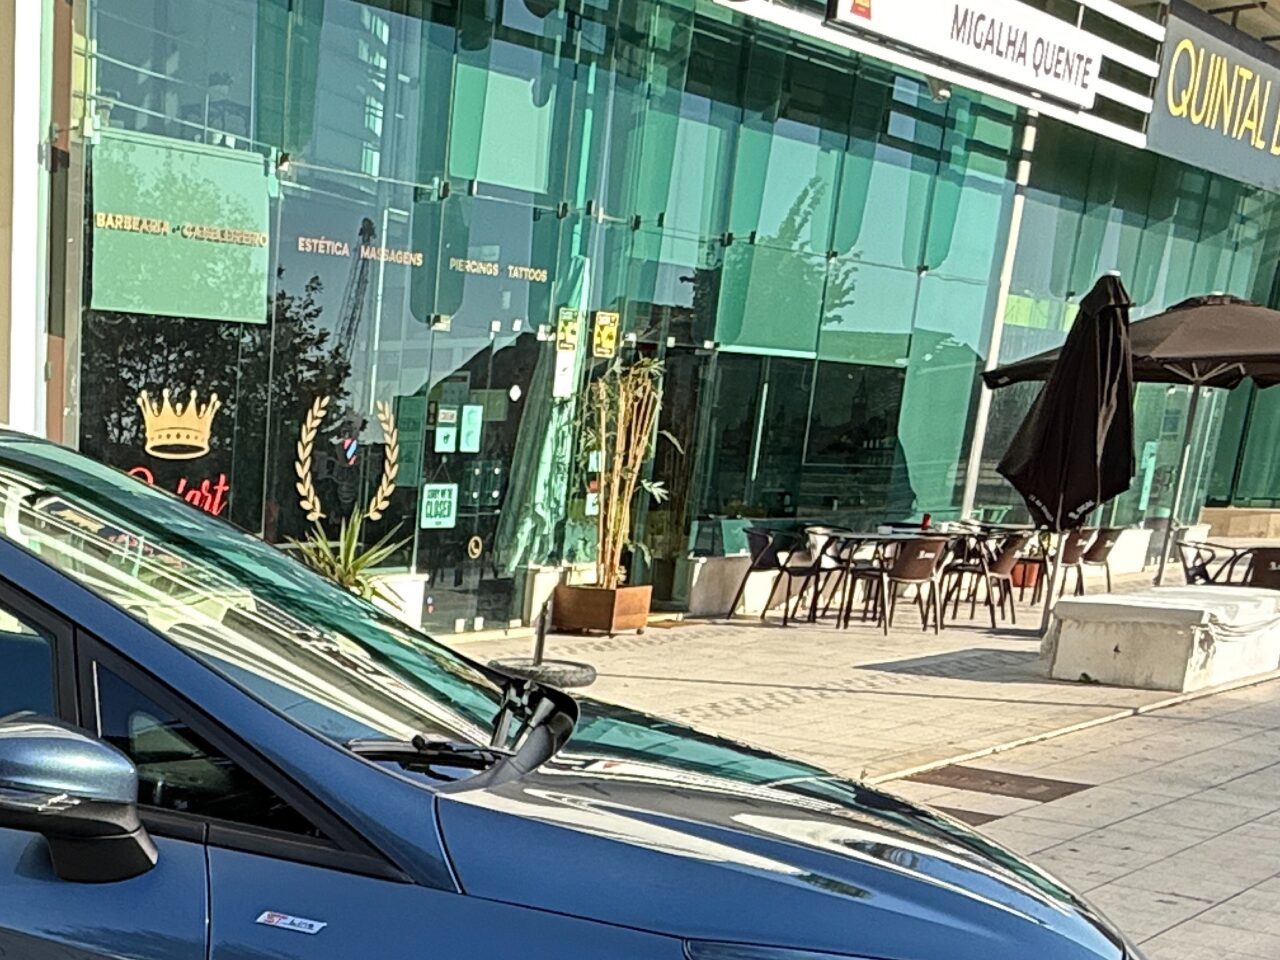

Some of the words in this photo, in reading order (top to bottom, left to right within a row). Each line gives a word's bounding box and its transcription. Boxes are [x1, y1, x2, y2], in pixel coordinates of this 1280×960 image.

[949, 3, 1029, 67] MIGALHA
[1032, 36, 1093, 90] QUENTE
[1167, 38, 1272, 150] QUINTAL
[297, 235, 351, 257] ESTÉTICA
[360, 245, 424, 267] MASSAGENS
[449, 256, 499, 277] PIERCINGS
[507, 264, 548, 283] TATTOOS
